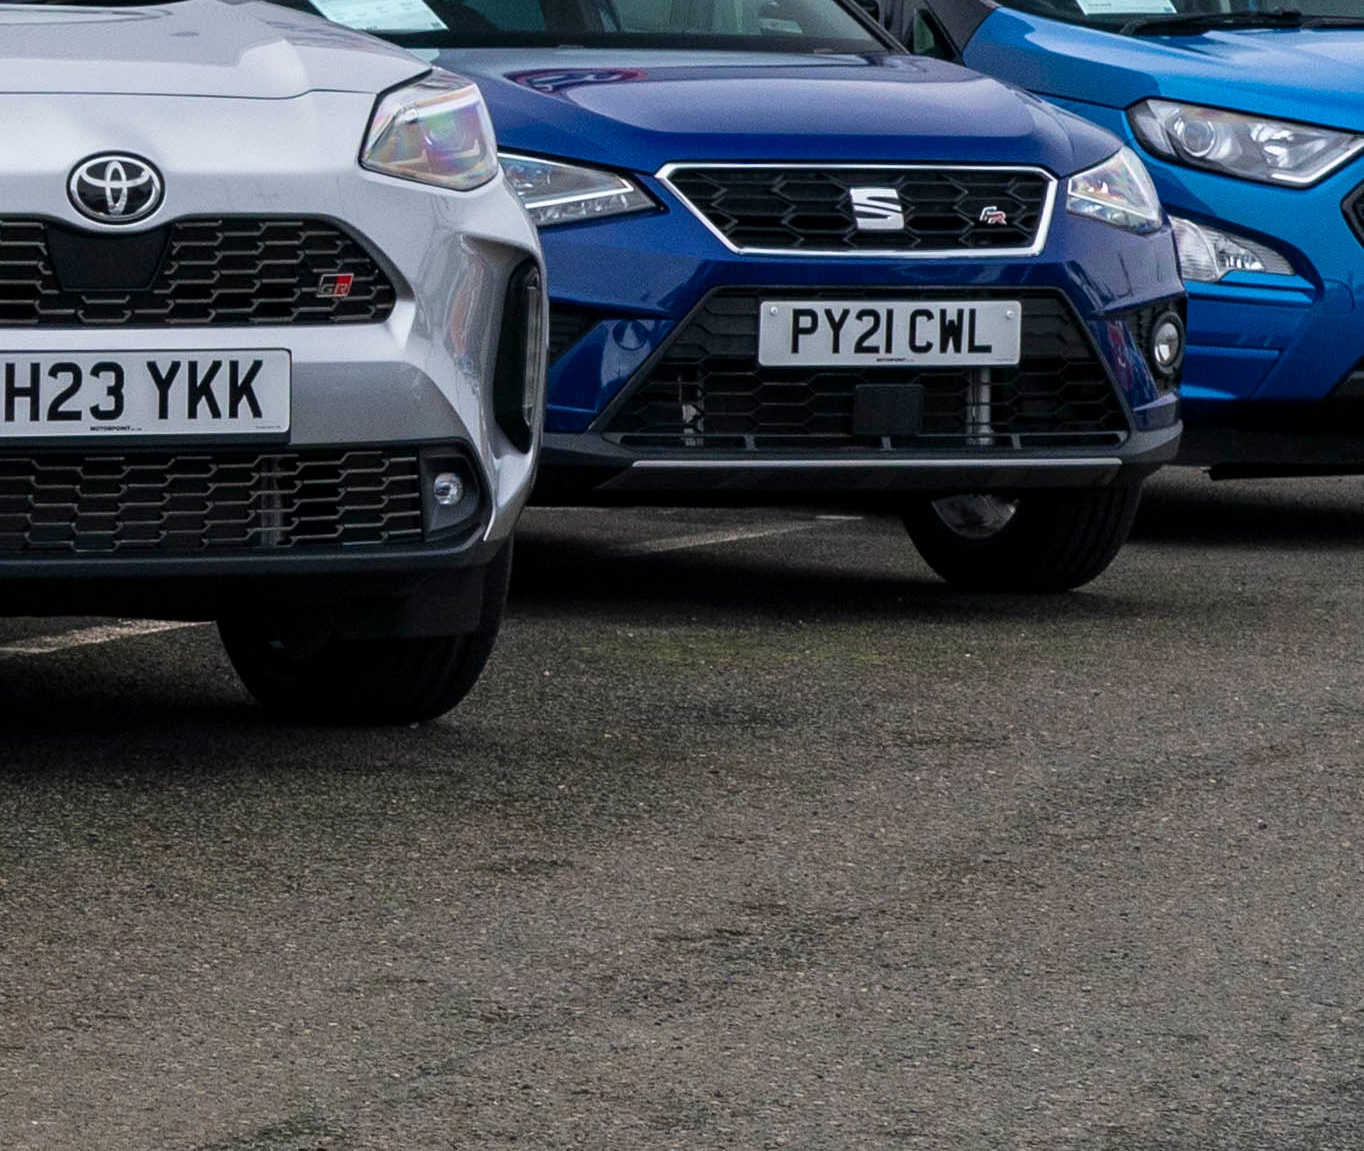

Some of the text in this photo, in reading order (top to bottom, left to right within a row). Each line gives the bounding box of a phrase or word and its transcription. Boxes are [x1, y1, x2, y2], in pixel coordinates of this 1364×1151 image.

[791, 308, 993, 354] PY21 CWL
[146, 360, 264, 420] YKK
